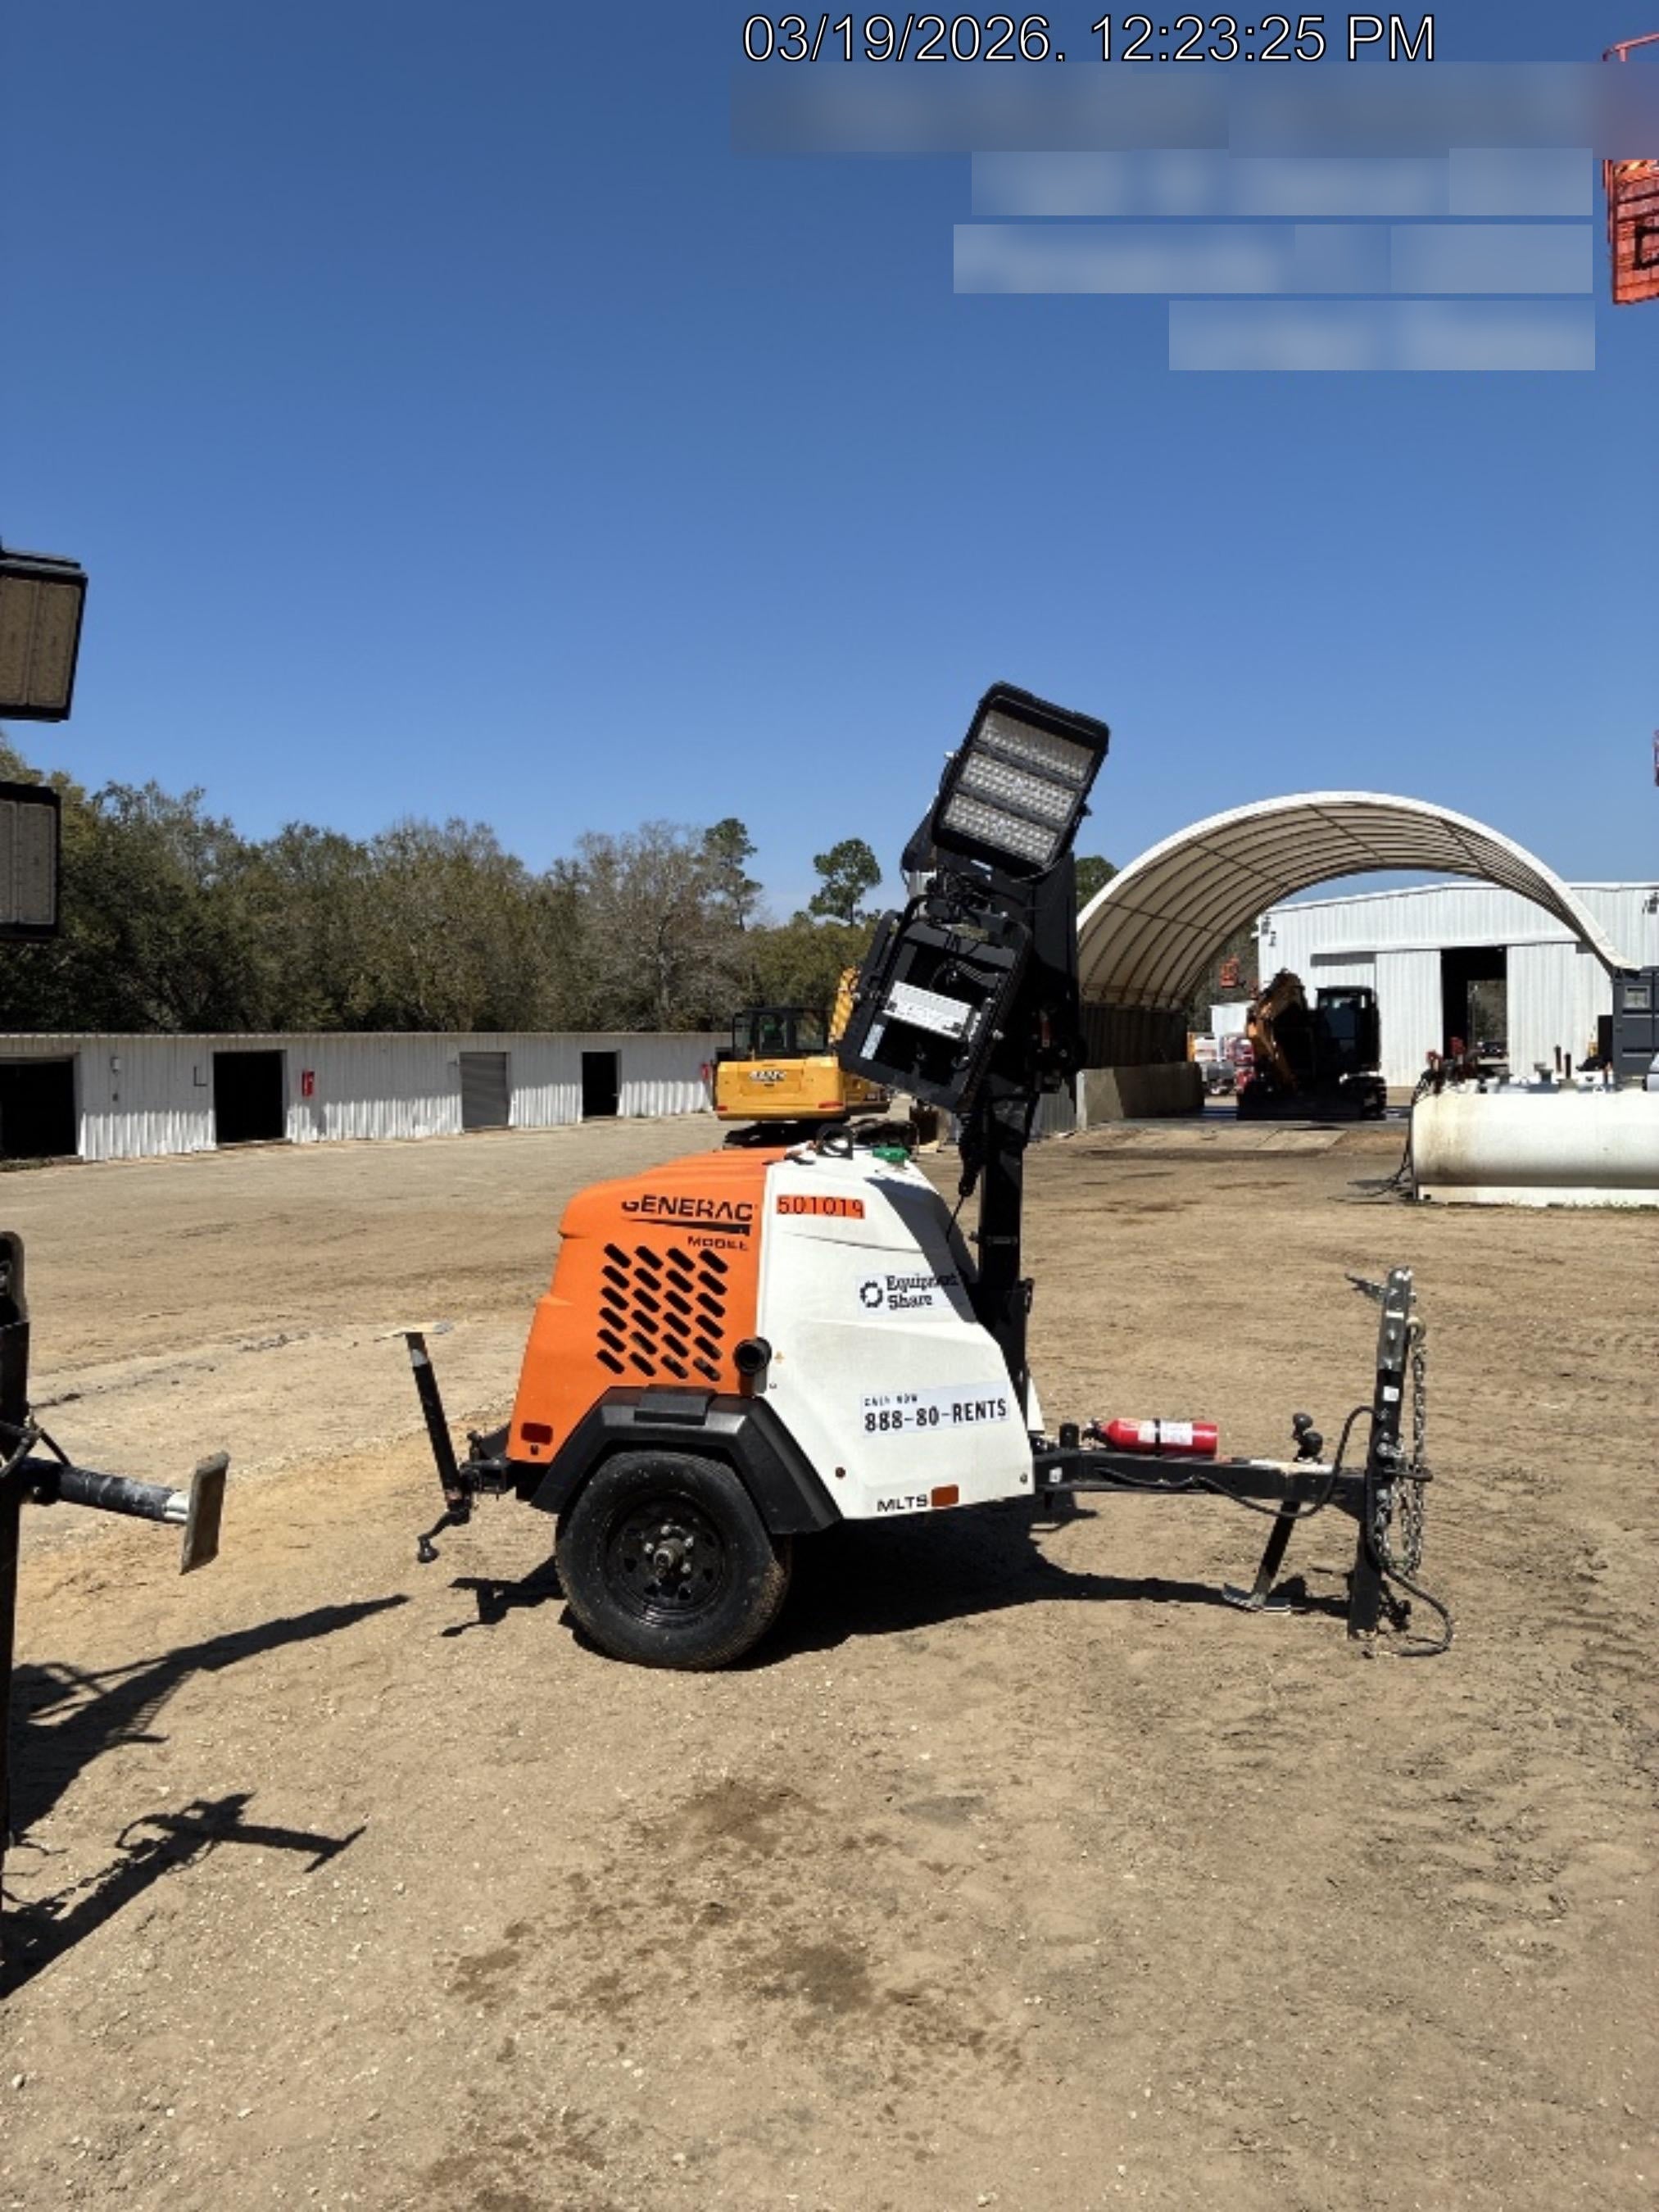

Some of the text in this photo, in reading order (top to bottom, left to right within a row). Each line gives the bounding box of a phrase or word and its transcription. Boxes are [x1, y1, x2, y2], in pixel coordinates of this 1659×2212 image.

[621, 1194, 754, 1222] GENERAC
[777, 1195, 865, 1219] 501019
[887, 1294, 932, 1310] Share
[864, 1398, 1006, 1432] 888-80-RENTS
[877, 1494, 927, 1512] MLTS
